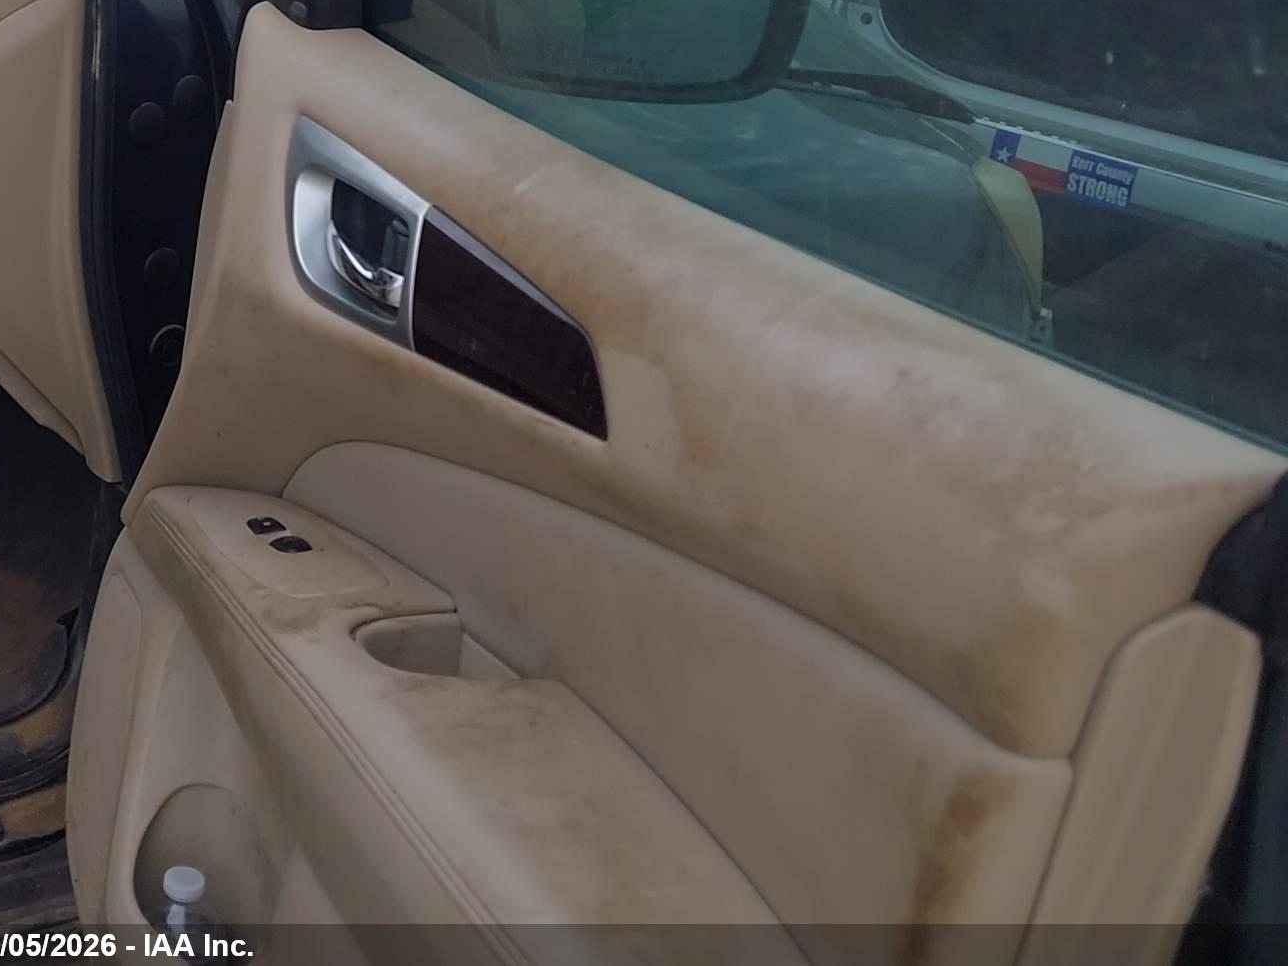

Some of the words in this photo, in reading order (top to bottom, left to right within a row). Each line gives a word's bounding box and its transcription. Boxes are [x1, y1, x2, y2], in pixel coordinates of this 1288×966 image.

[1073, 156, 1094, 172] Kerr
[1096, 163, 1133, 183] County
[1068, 173, 1128, 206] STRONG
